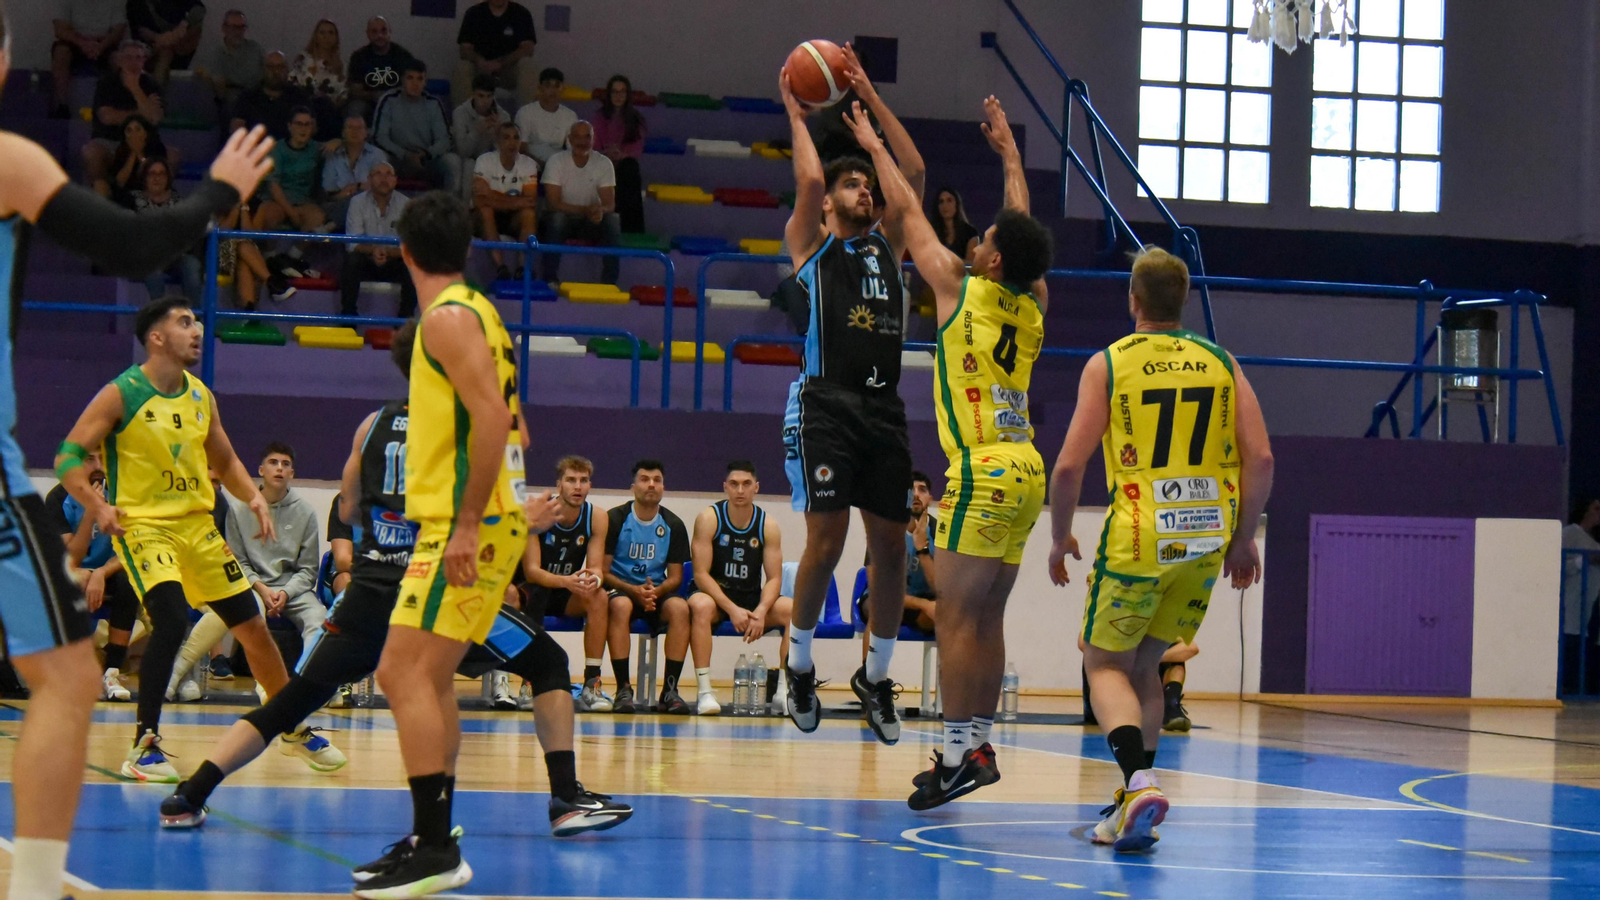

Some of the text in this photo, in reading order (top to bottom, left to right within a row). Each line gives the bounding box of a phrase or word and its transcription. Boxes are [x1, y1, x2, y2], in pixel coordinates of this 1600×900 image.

[964, 310, 974, 346] RUSTER
[992, 322, 1019, 378] 4
[1142, 360, 1208, 376] ÓSCAR
[173, 413, 182, 429] 9
[1119, 394, 1134, 436] RUSTER
[1141, 386, 1216, 469] 77
[815, 489, 836, 497] vive
[1188, 478, 1209, 491] ORO
[1190, 514, 1219, 522] FORTUNA
[628, 542, 656, 560] ULB
[724, 562, 749, 579] ULB
